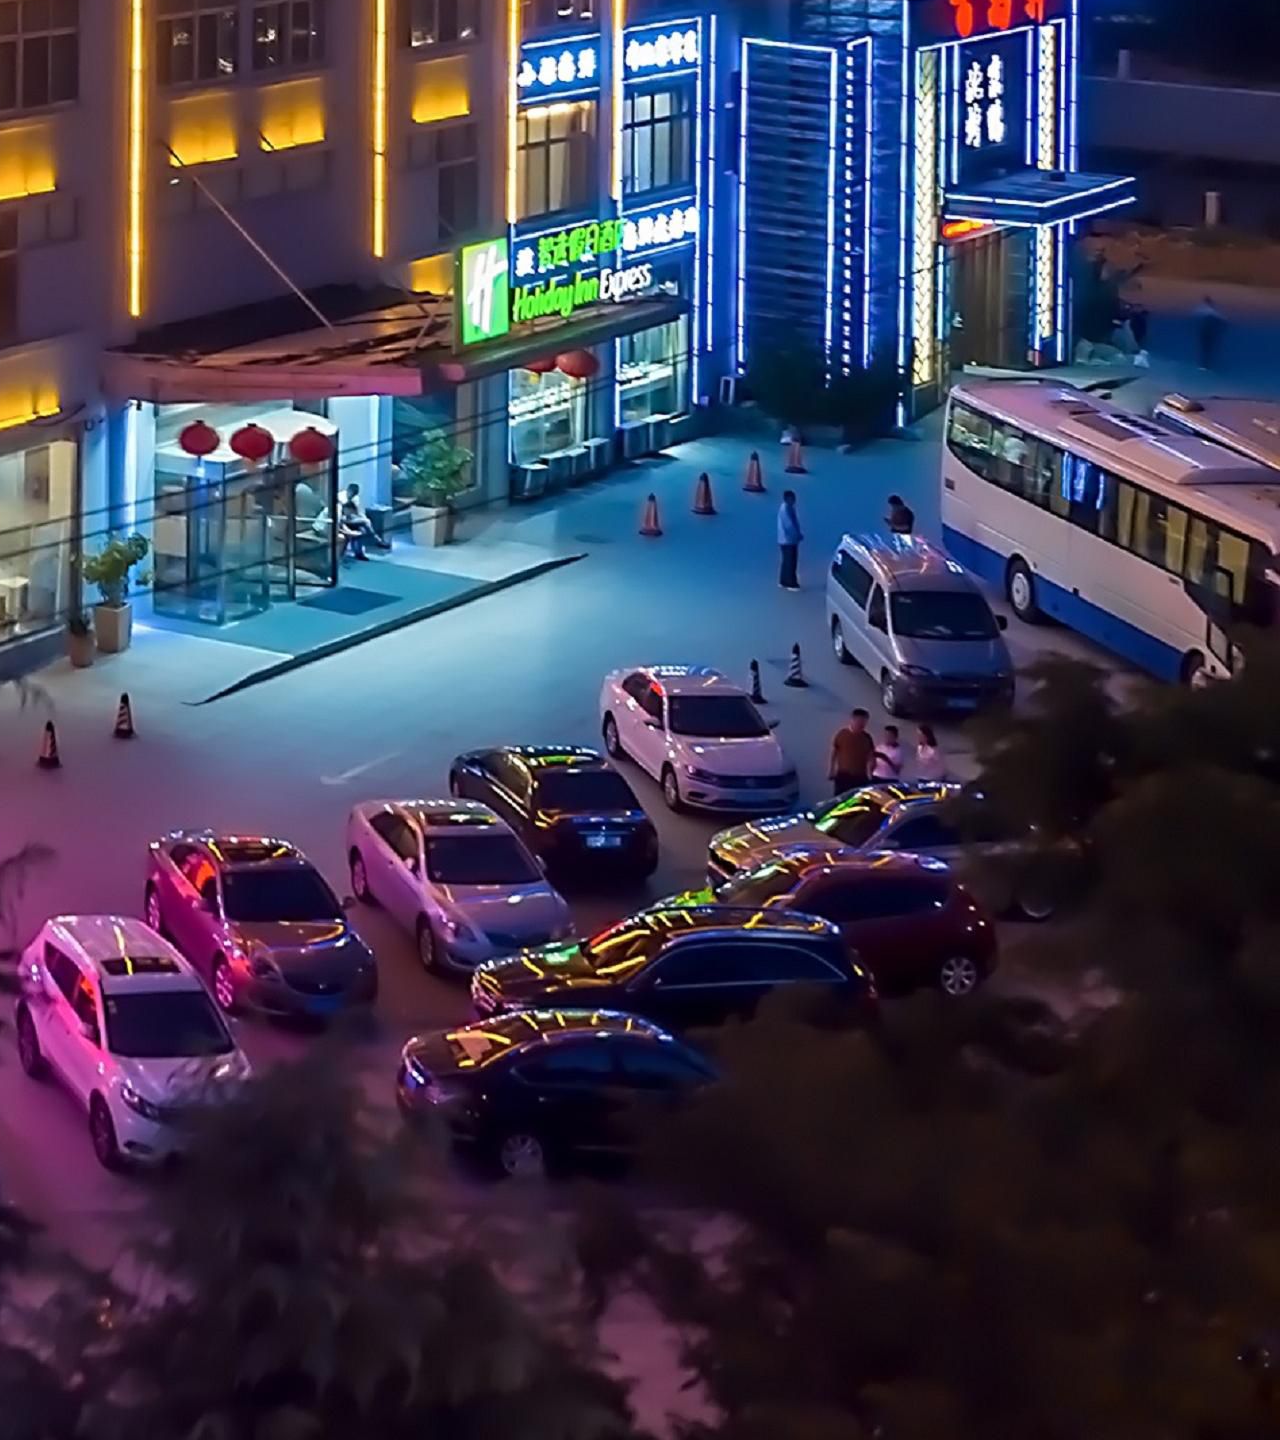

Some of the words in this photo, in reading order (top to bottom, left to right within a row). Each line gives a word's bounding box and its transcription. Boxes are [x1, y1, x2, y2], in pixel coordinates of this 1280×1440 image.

[512, 274, 573, 323] Holiday
[574, 272, 599, 304] Inn
[599, 262, 653, 304] Express
